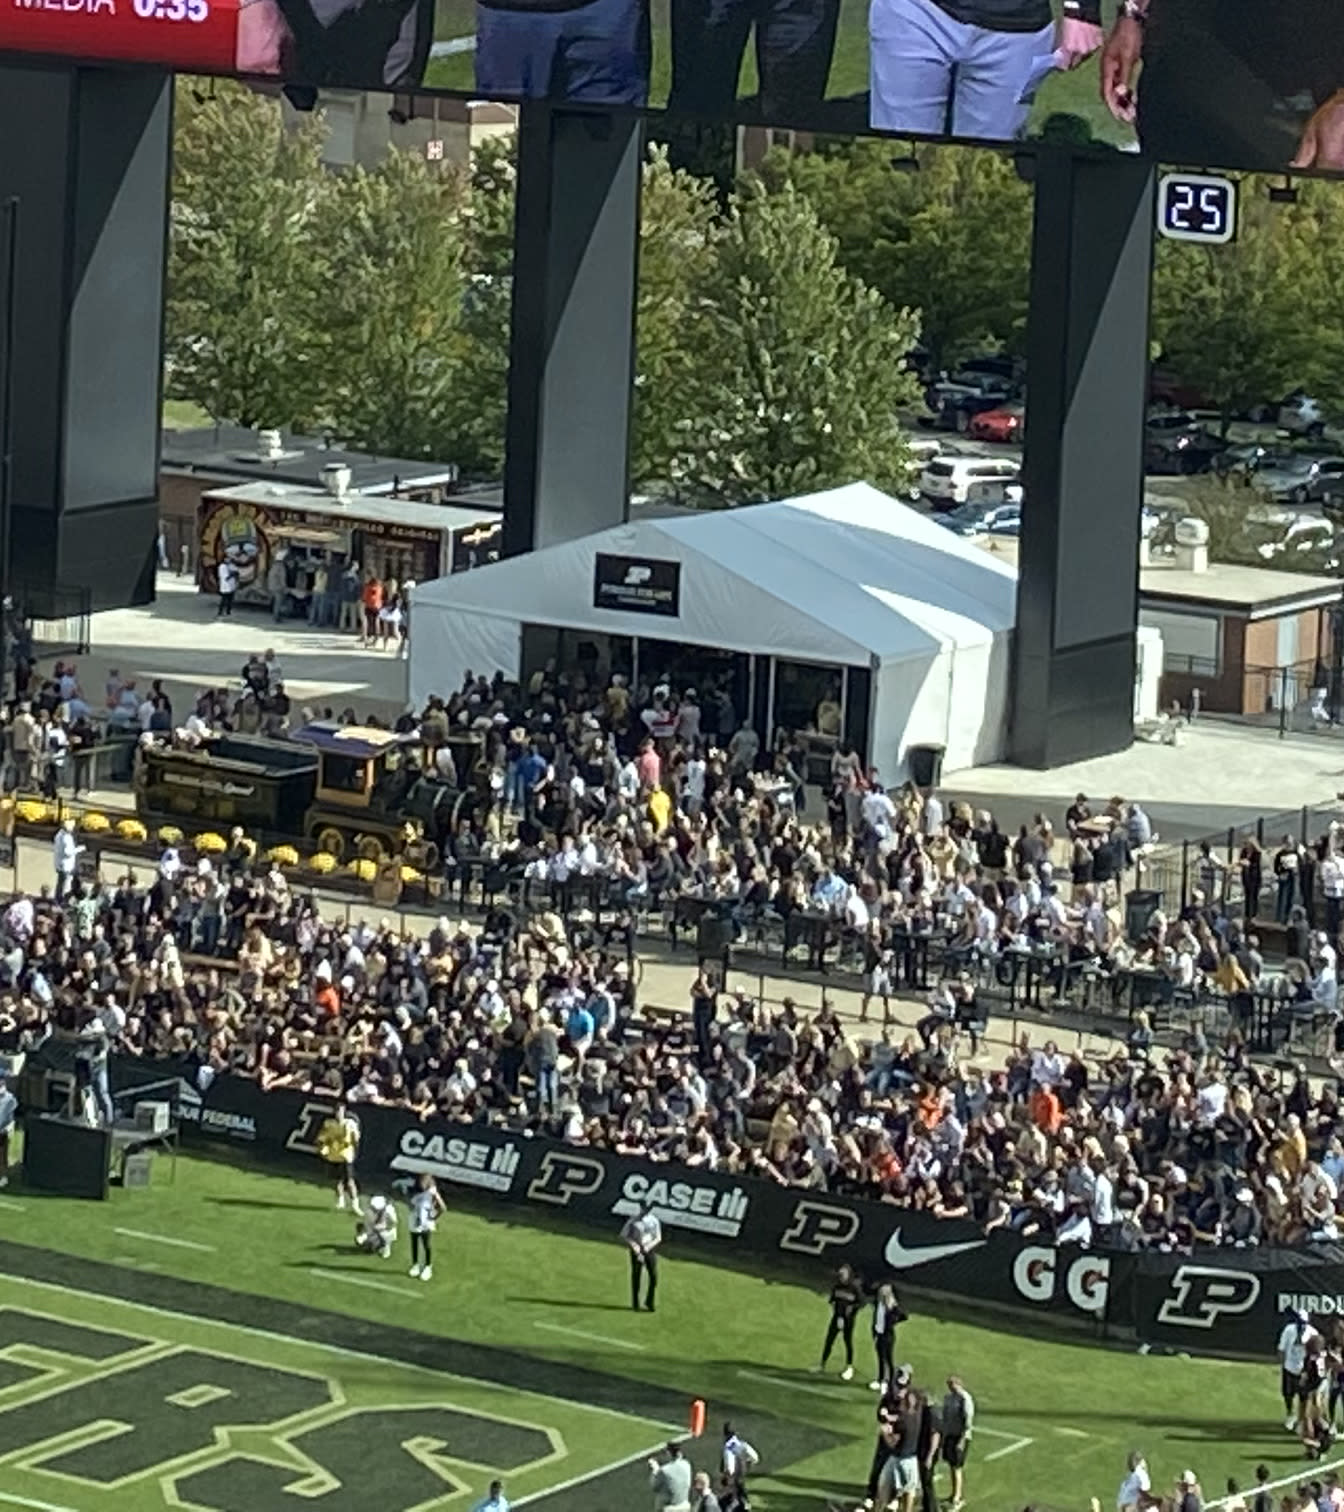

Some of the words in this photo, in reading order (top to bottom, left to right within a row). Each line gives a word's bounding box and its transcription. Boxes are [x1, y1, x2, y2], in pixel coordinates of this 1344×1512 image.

[1171, 186, 1220, 230] 25
[202, 1109, 256, 1132] FEDERAL
[400, 1130, 490, 1169] CASE
[527, 1152, 605, 1205] P
[622, 1174, 717, 1213] CASE
[780, 1201, 859, 1255] P
[1013, 1246, 1055, 1301] G
[1067, 1256, 1110, 1311] G
[1158, 1266, 1261, 1328] P
